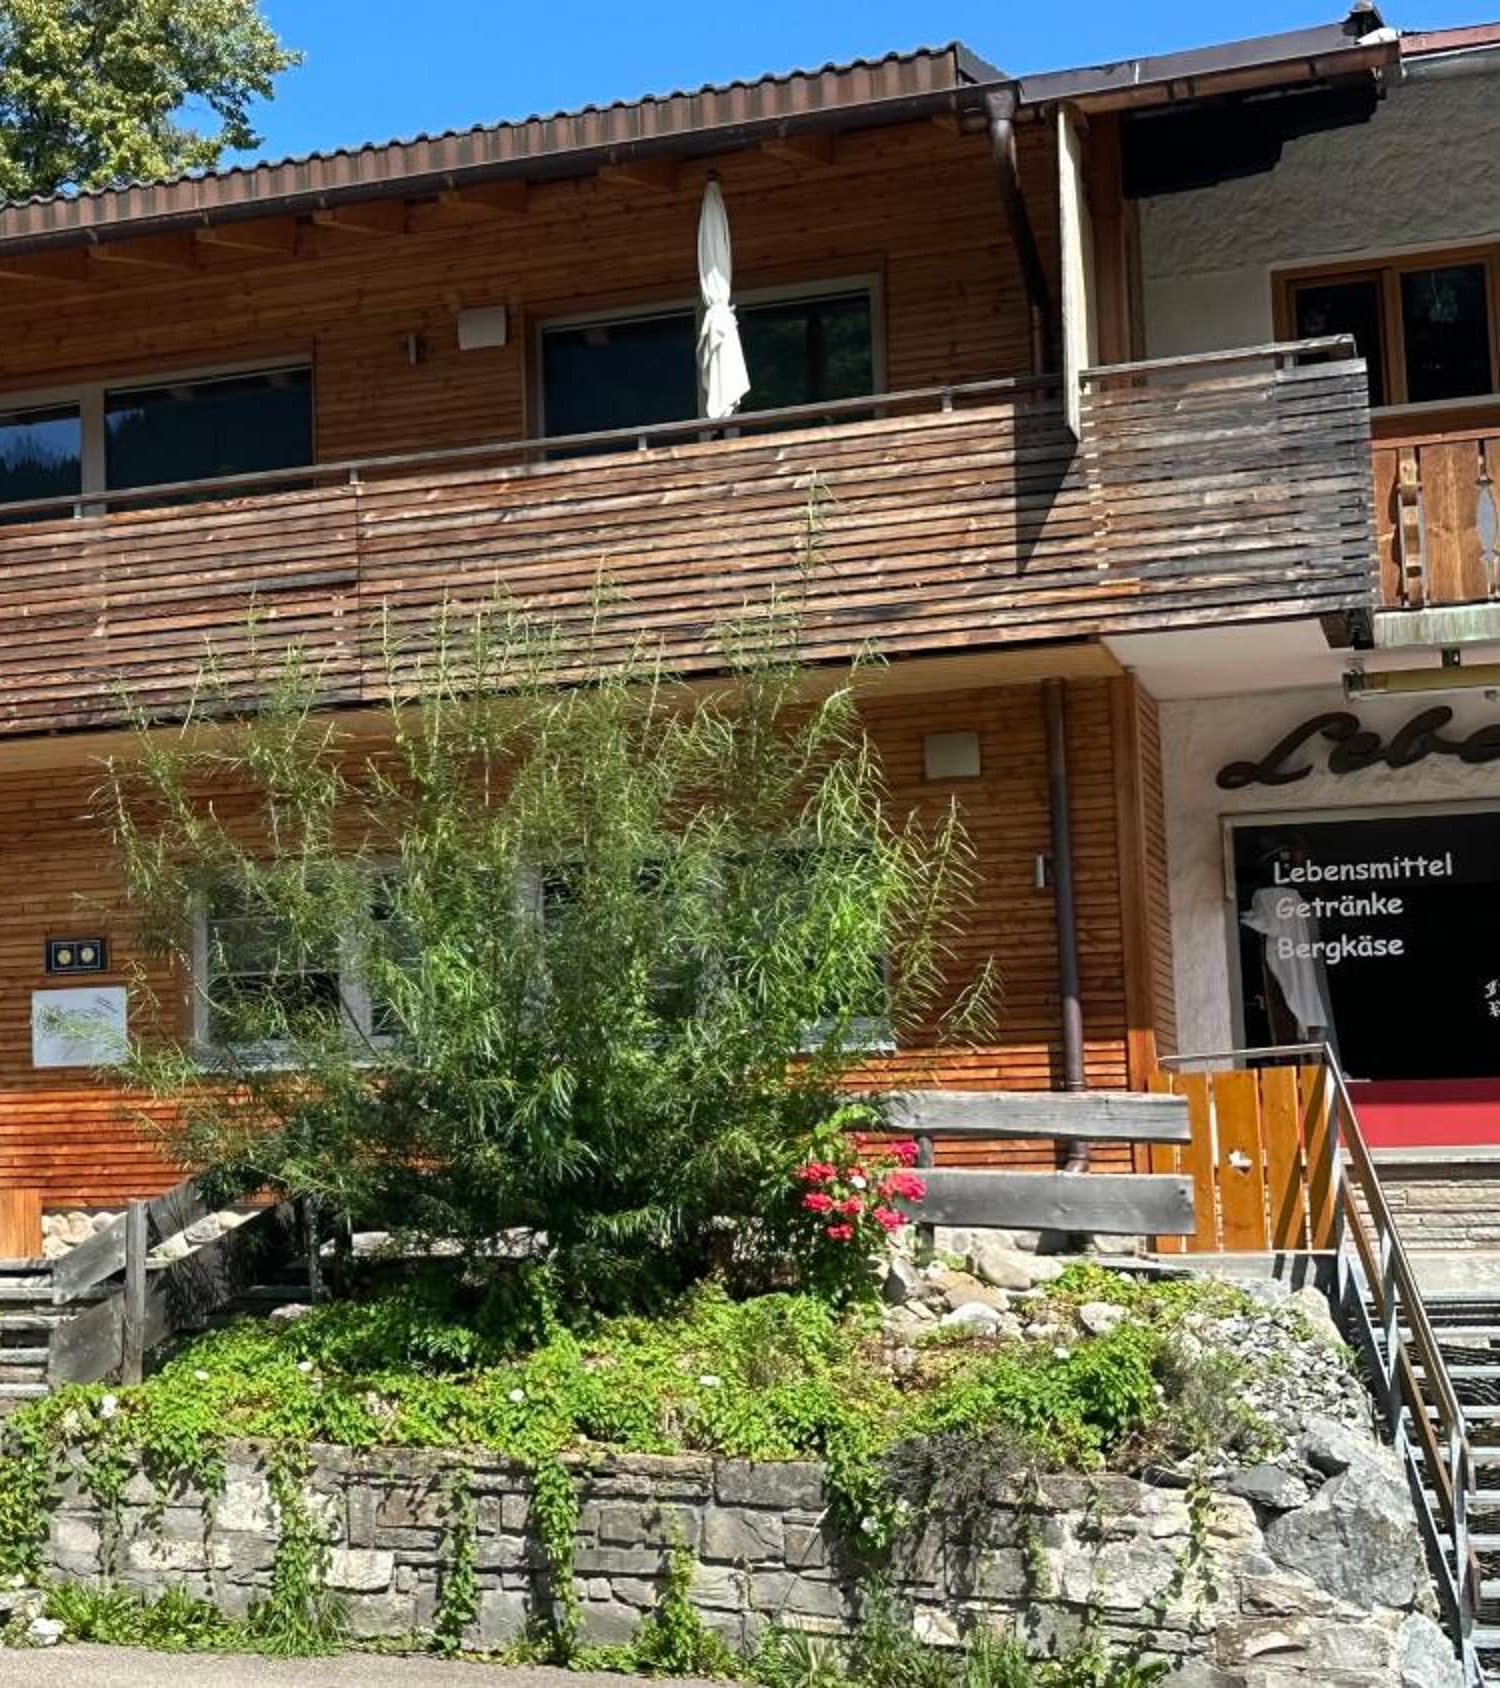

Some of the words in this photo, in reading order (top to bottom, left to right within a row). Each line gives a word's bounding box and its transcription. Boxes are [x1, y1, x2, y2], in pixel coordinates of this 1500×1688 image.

[1273, 852, 1453, 885] Lebensmittel
[1275, 891, 1404, 920] Getränke
[1277, 934, 1405, 965] Bergkäse
